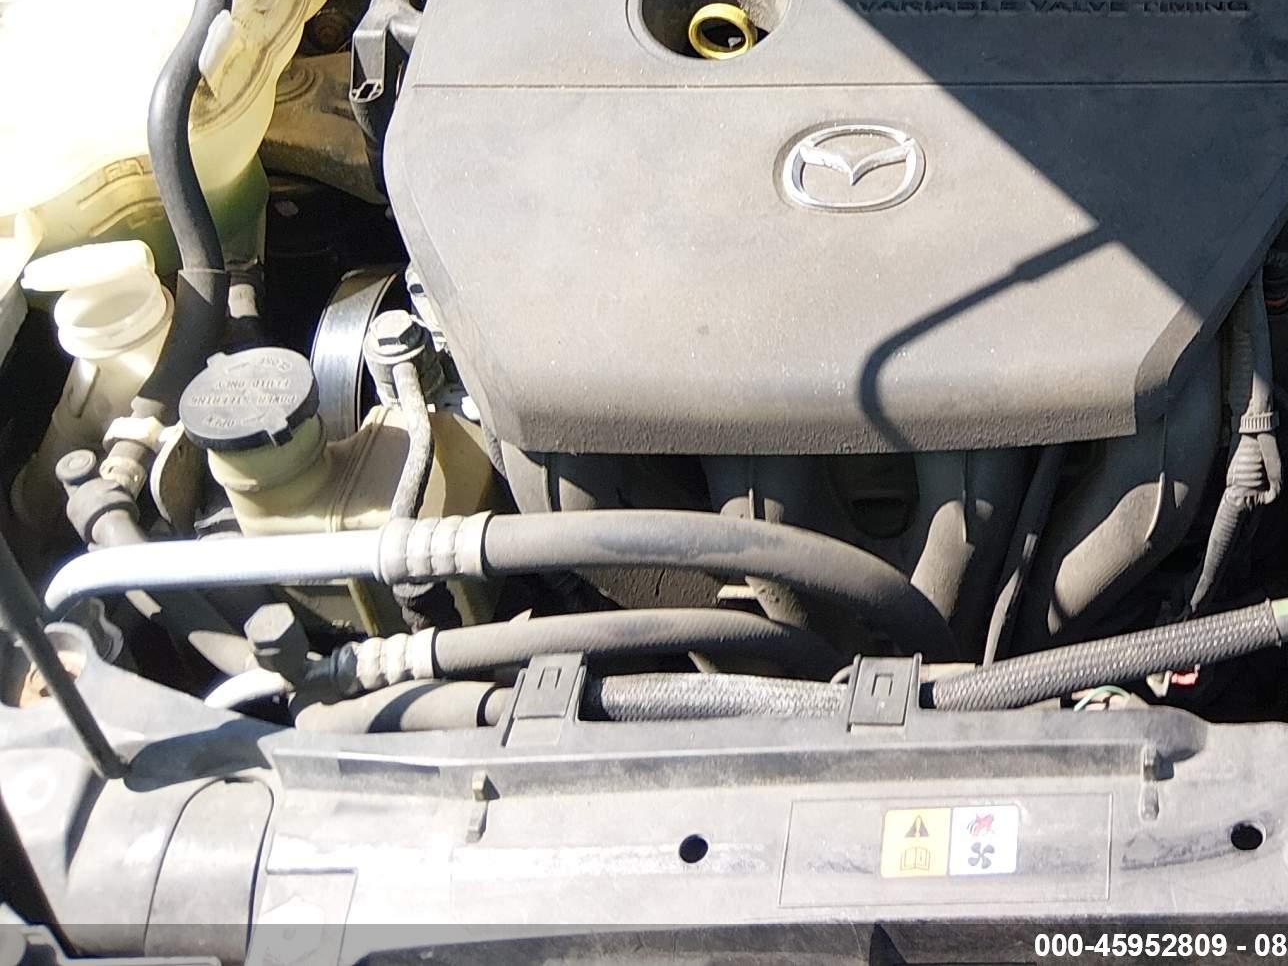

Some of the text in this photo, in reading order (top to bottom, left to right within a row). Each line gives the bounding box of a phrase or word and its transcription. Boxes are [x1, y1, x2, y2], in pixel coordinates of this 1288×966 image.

[857, 0, 1249, 12] VARIABLE VALVE TIMING
